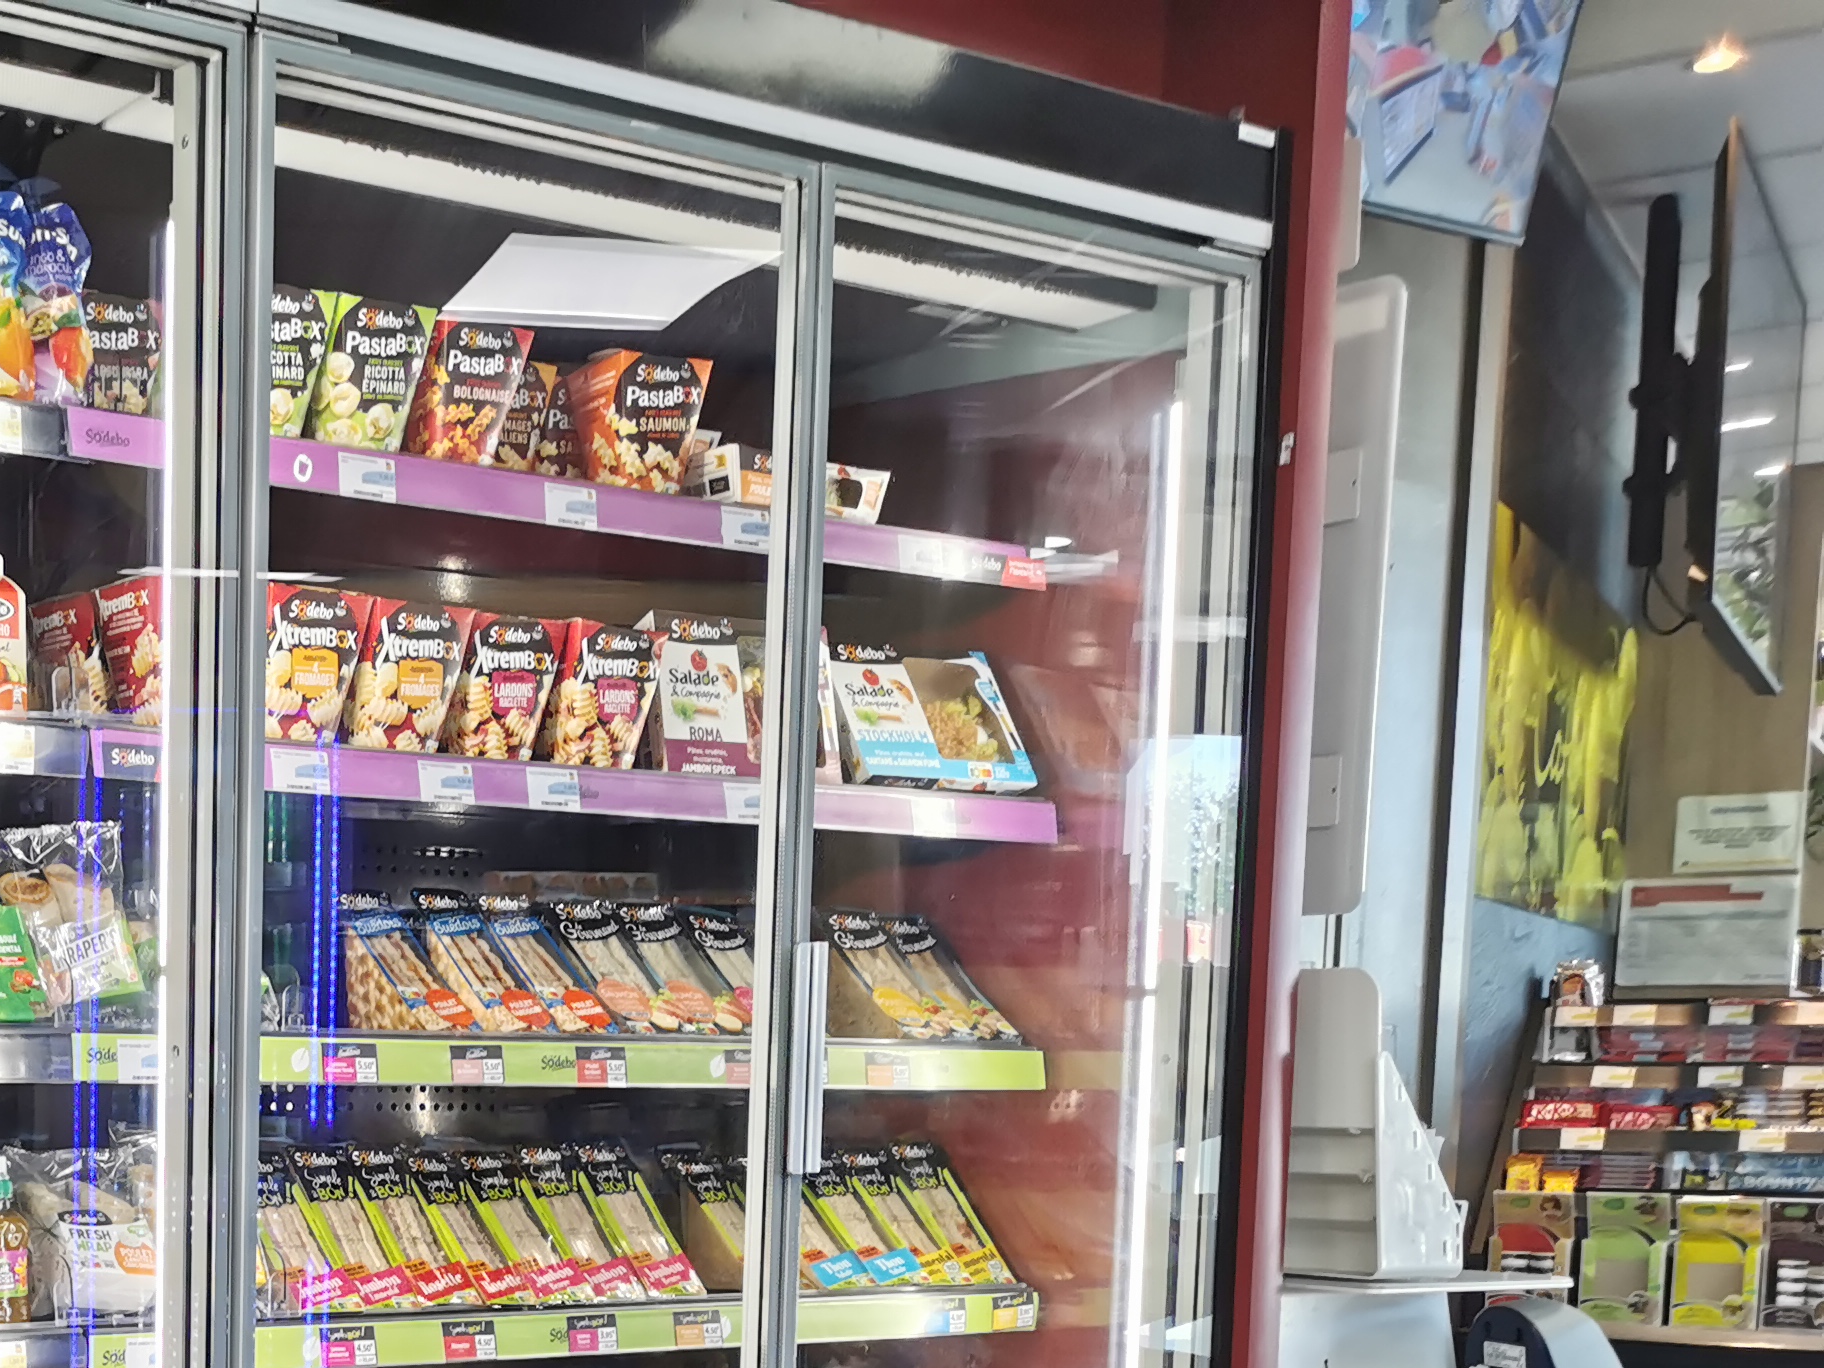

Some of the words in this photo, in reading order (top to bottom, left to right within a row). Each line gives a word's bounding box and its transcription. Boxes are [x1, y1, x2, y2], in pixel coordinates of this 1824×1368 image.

[356, 307, 403, 330] Sodebo
[458, 327, 502, 351] Sodebo
[364, 364, 406, 381] RICOTTA
[635, 364, 680, 384] Sodebo
[453, 384, 511, 403] BOLOGNAISE
[639, 416, 687, 433] SAUMON
[288, 599, 334, 620] Sodebo
[396, 612, 440, 632] Sodebo
[671, 618, 721, 641] Sodebo
[488, 624, 531, 645] Sodebo
[595, 633, 637, 652] Sodebo
[837, 644, 886, 661] Sodebo
[312, 662, 319, 673] 4
[294, 672, 335, 686] FROMAGES
[418, 673, 425, 684] 4
[669, 667, 719, 686] Salade
[401, 683, 440, 697] FROMAGES
[494, 682, 533, 699] LARDONS
[599, 689, 637, 705] LARDONS
[845, 681, 894, 699] Salade
[689, 726, 723, 742] ROMA
[857, 728, 929, 743] STOCKHOLM
[681, 762, 711, 774] JAMBON
[712, 763, 736, 775] SPECK
[339, 893, 379, 909] Sodebo
[418, 893, 459, 909] Sodebo
[478, 895, 519, 911] Sodebo
[294, 1151, 338, 1167] Sodebo
[352, 1150, 394, 1166] Sodebo
[68, 1228, 112, 1241] FRESH
[820, 1258, 852, 1274] Thon
[875, 1256, 905, 1272] Thon
[418, 1271, 464, 1294] Rosette
[530, 1264, 574, 1286] Jambon
